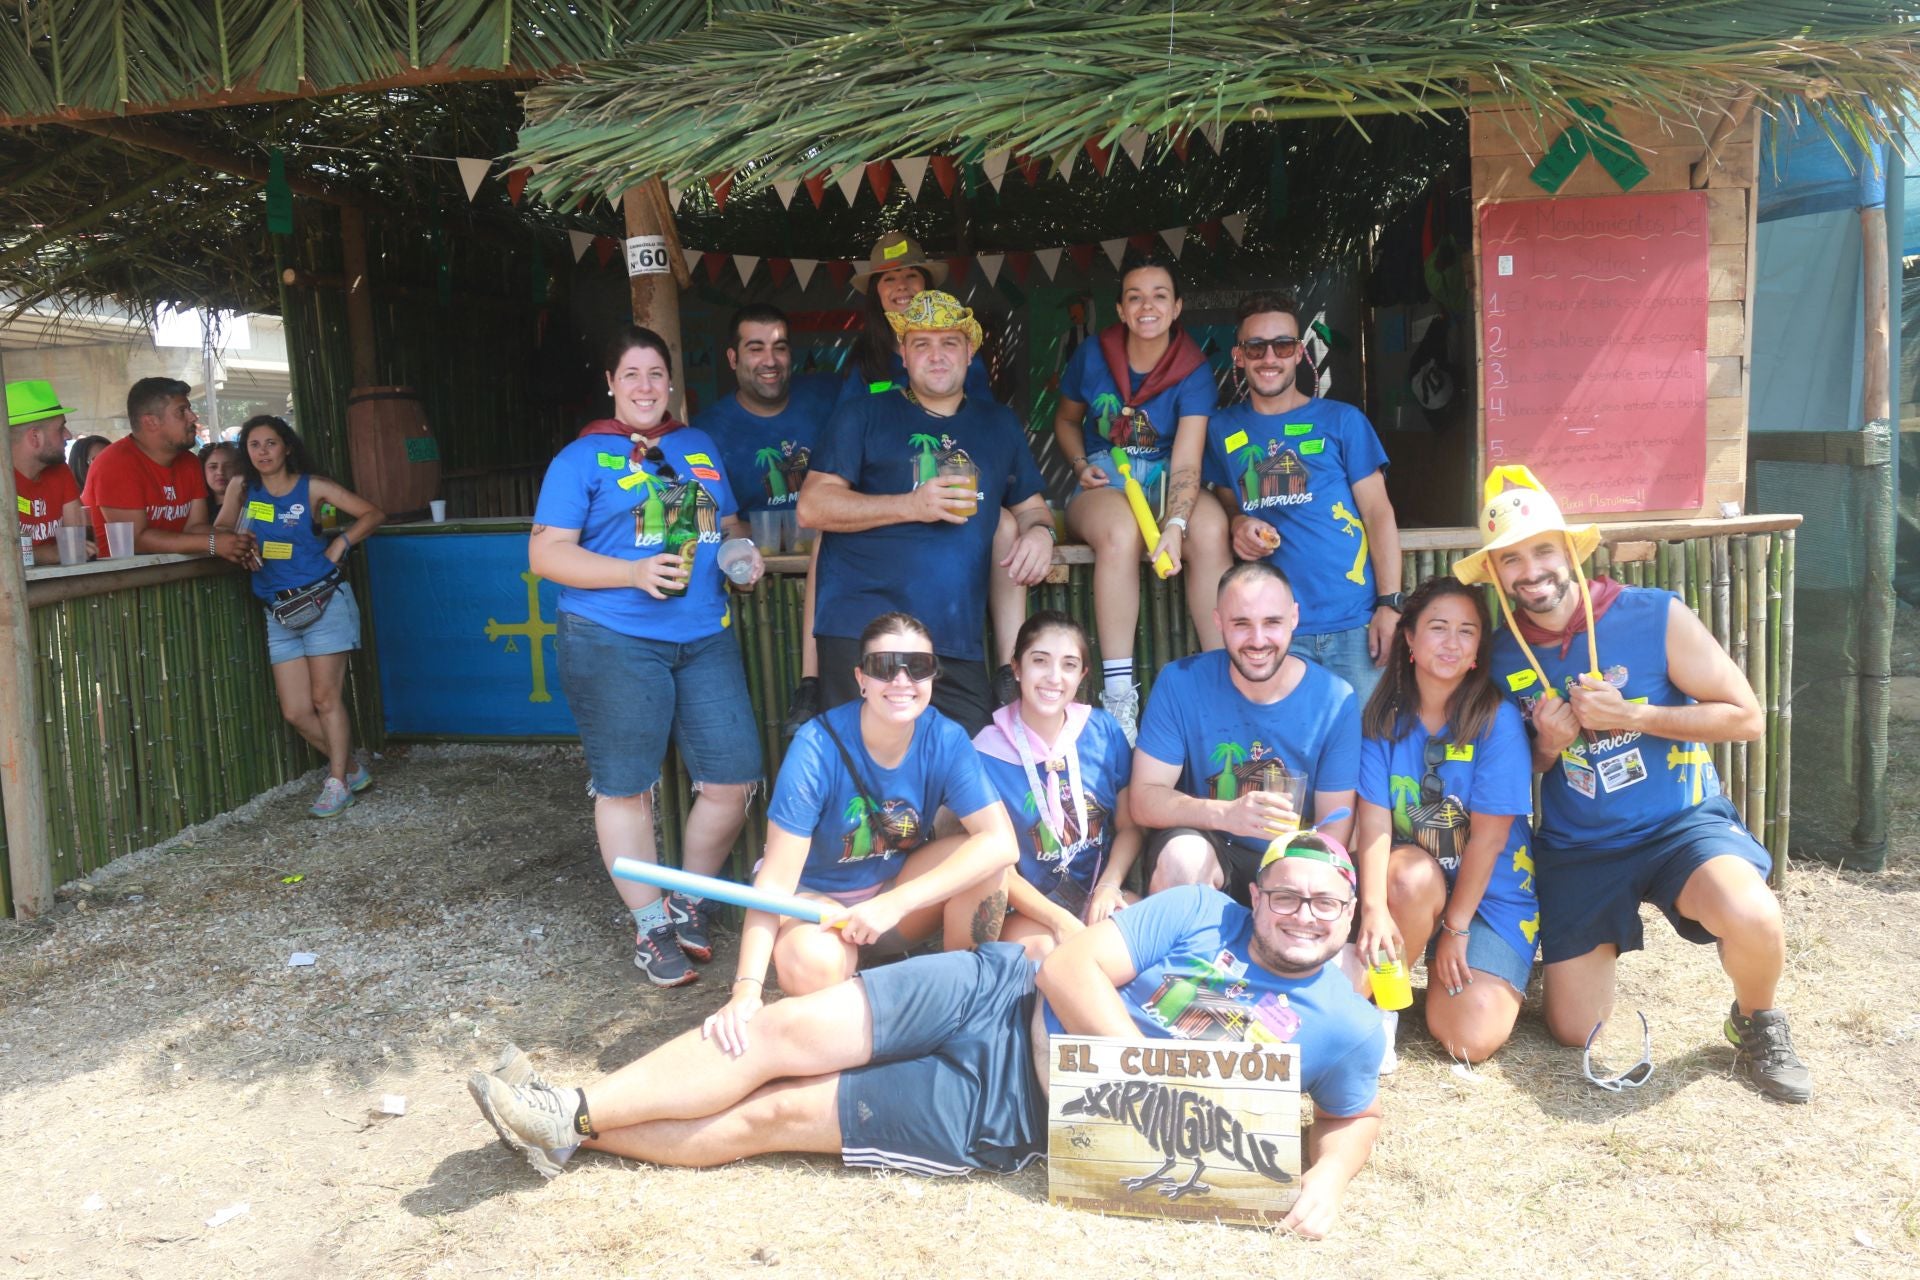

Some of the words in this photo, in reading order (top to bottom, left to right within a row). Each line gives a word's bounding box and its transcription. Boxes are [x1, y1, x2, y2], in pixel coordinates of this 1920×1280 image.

[639, 248, 668, 267] 60
[1261, 492, 1313, 509] MERUCOS
[634, 532, 663, 547] LOS
[1569, 743, 1587, 757] OS
[1036, 851, 1060, 862] LOS
[1058, 1044, 1099, 1073] EL
[1120, 1043, 1290, 1082] CUERVÓN
